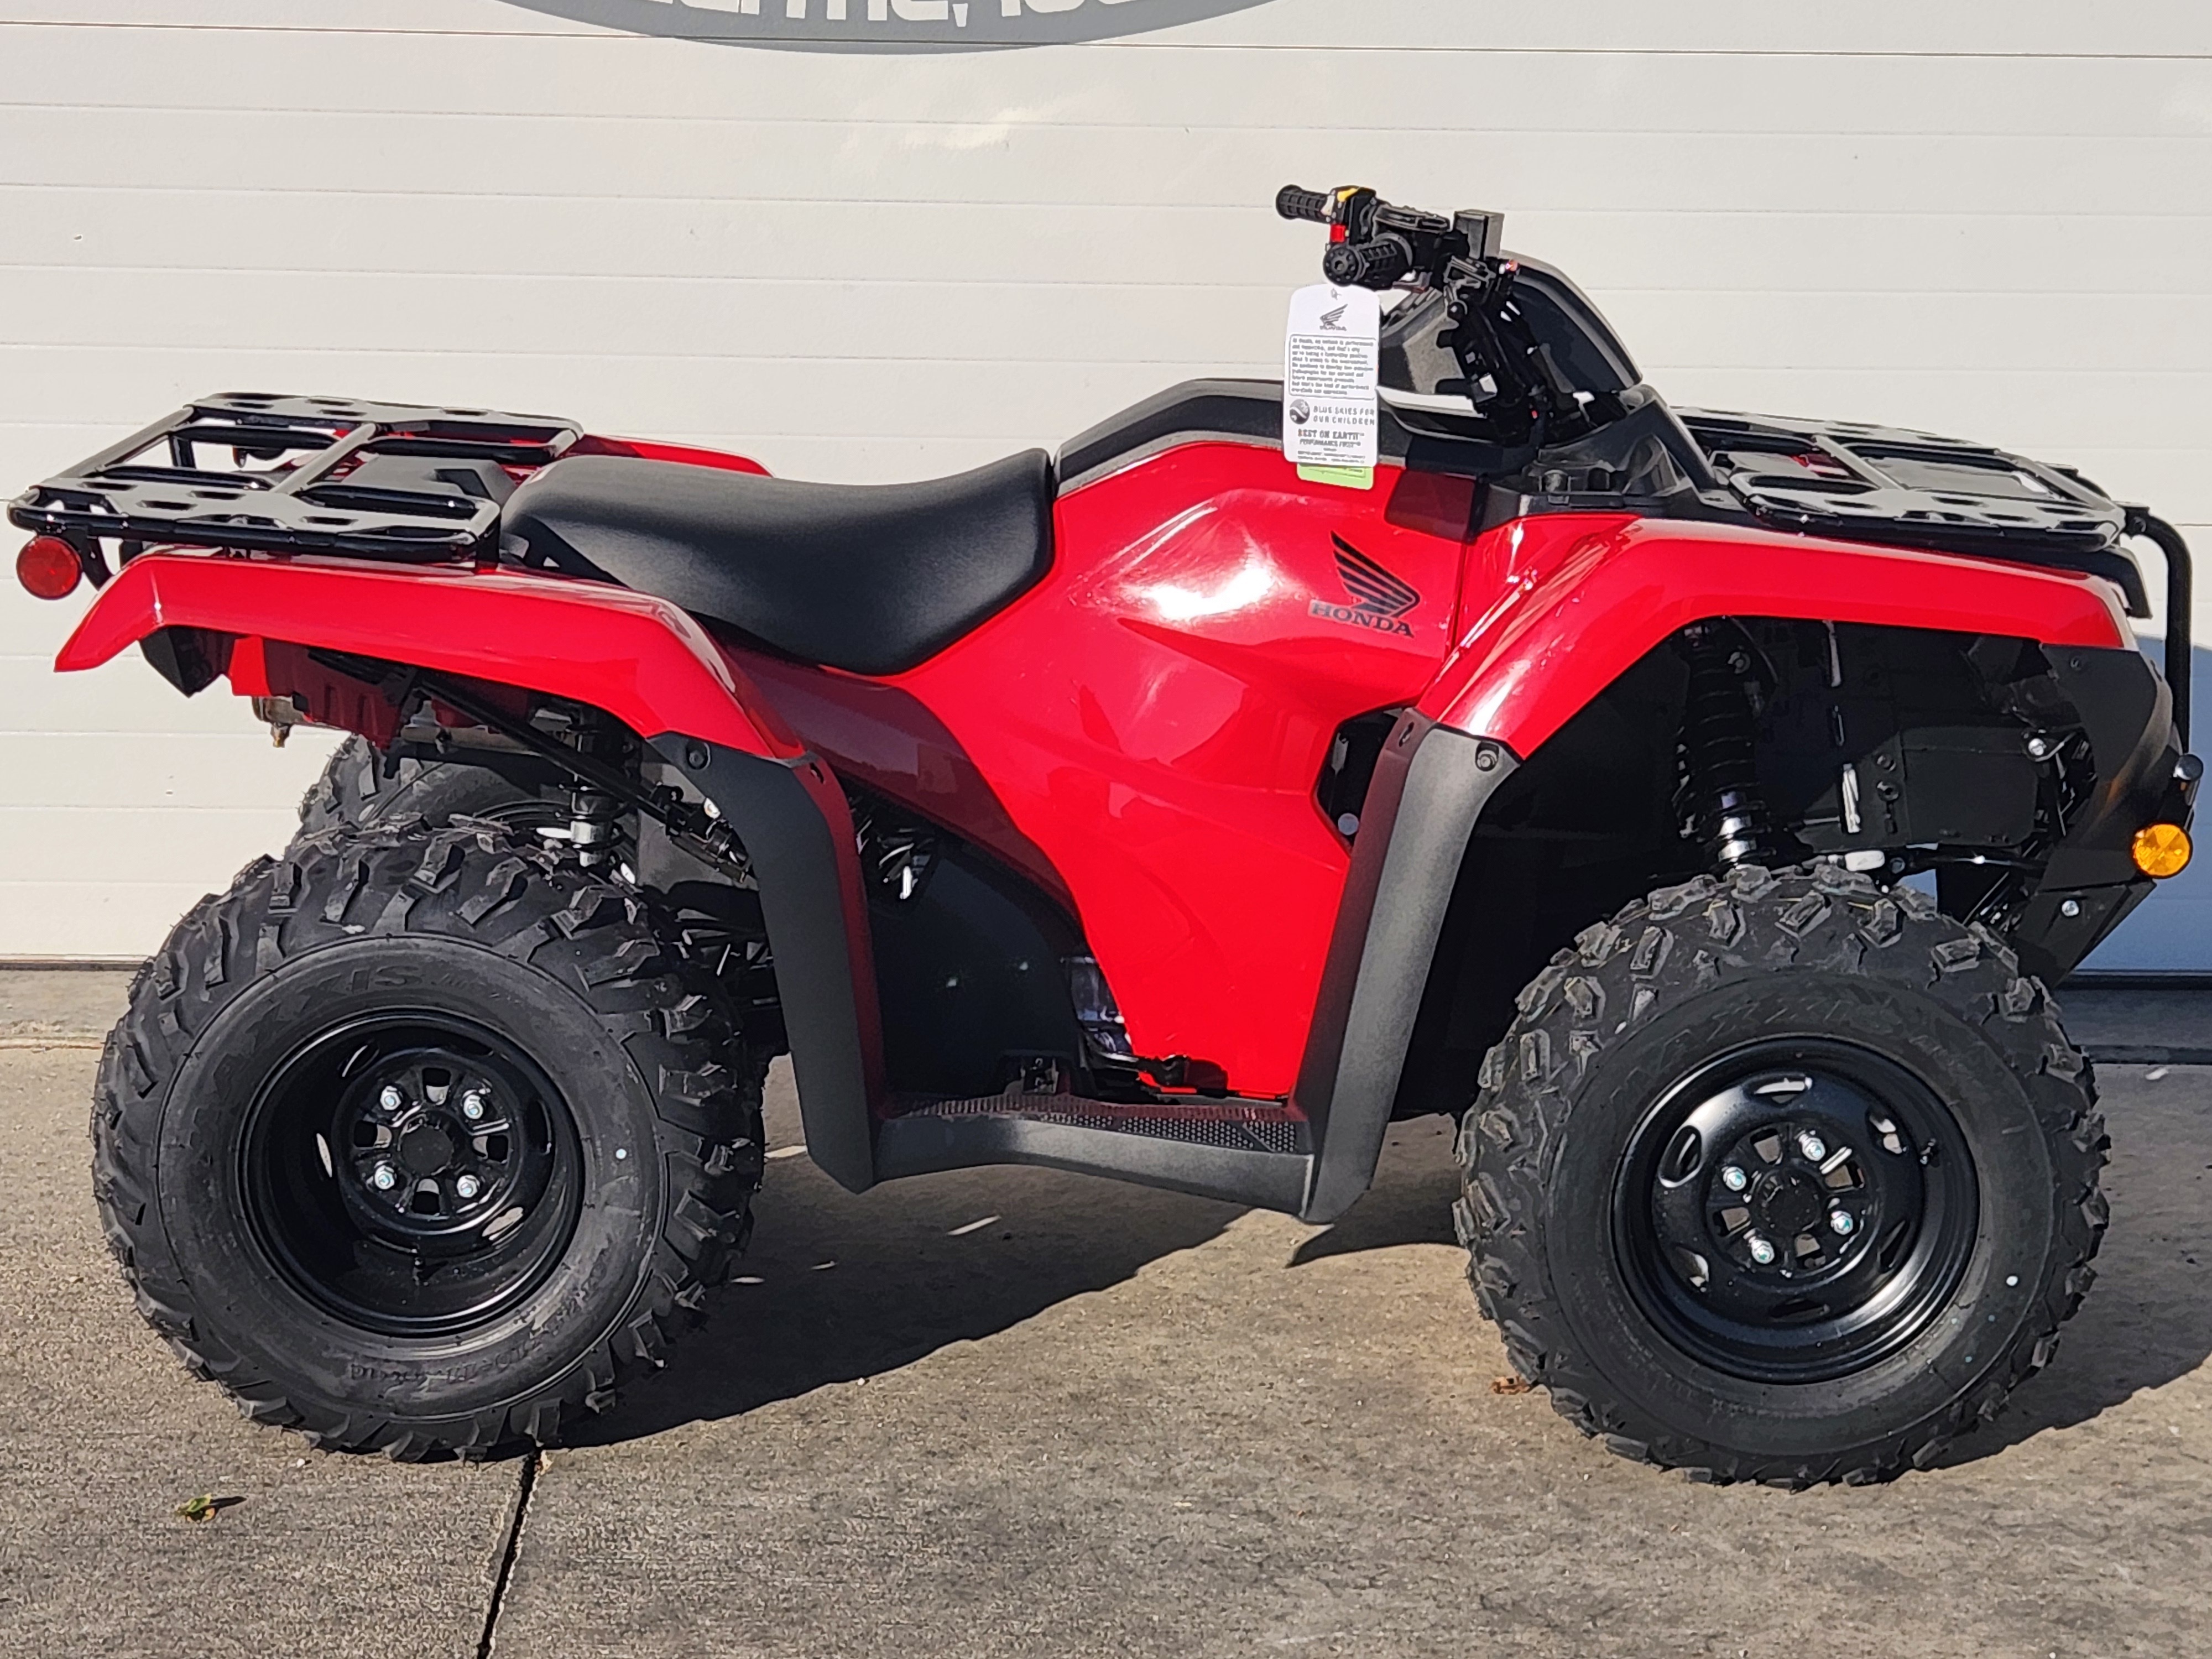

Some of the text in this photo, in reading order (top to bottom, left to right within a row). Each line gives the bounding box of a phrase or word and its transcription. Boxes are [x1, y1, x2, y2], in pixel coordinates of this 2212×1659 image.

[1313, 405, 1332, 414] BLUE
[1359, 408, 1375, 416] FOR
[1312, 601, 1414, 638] HONDA
